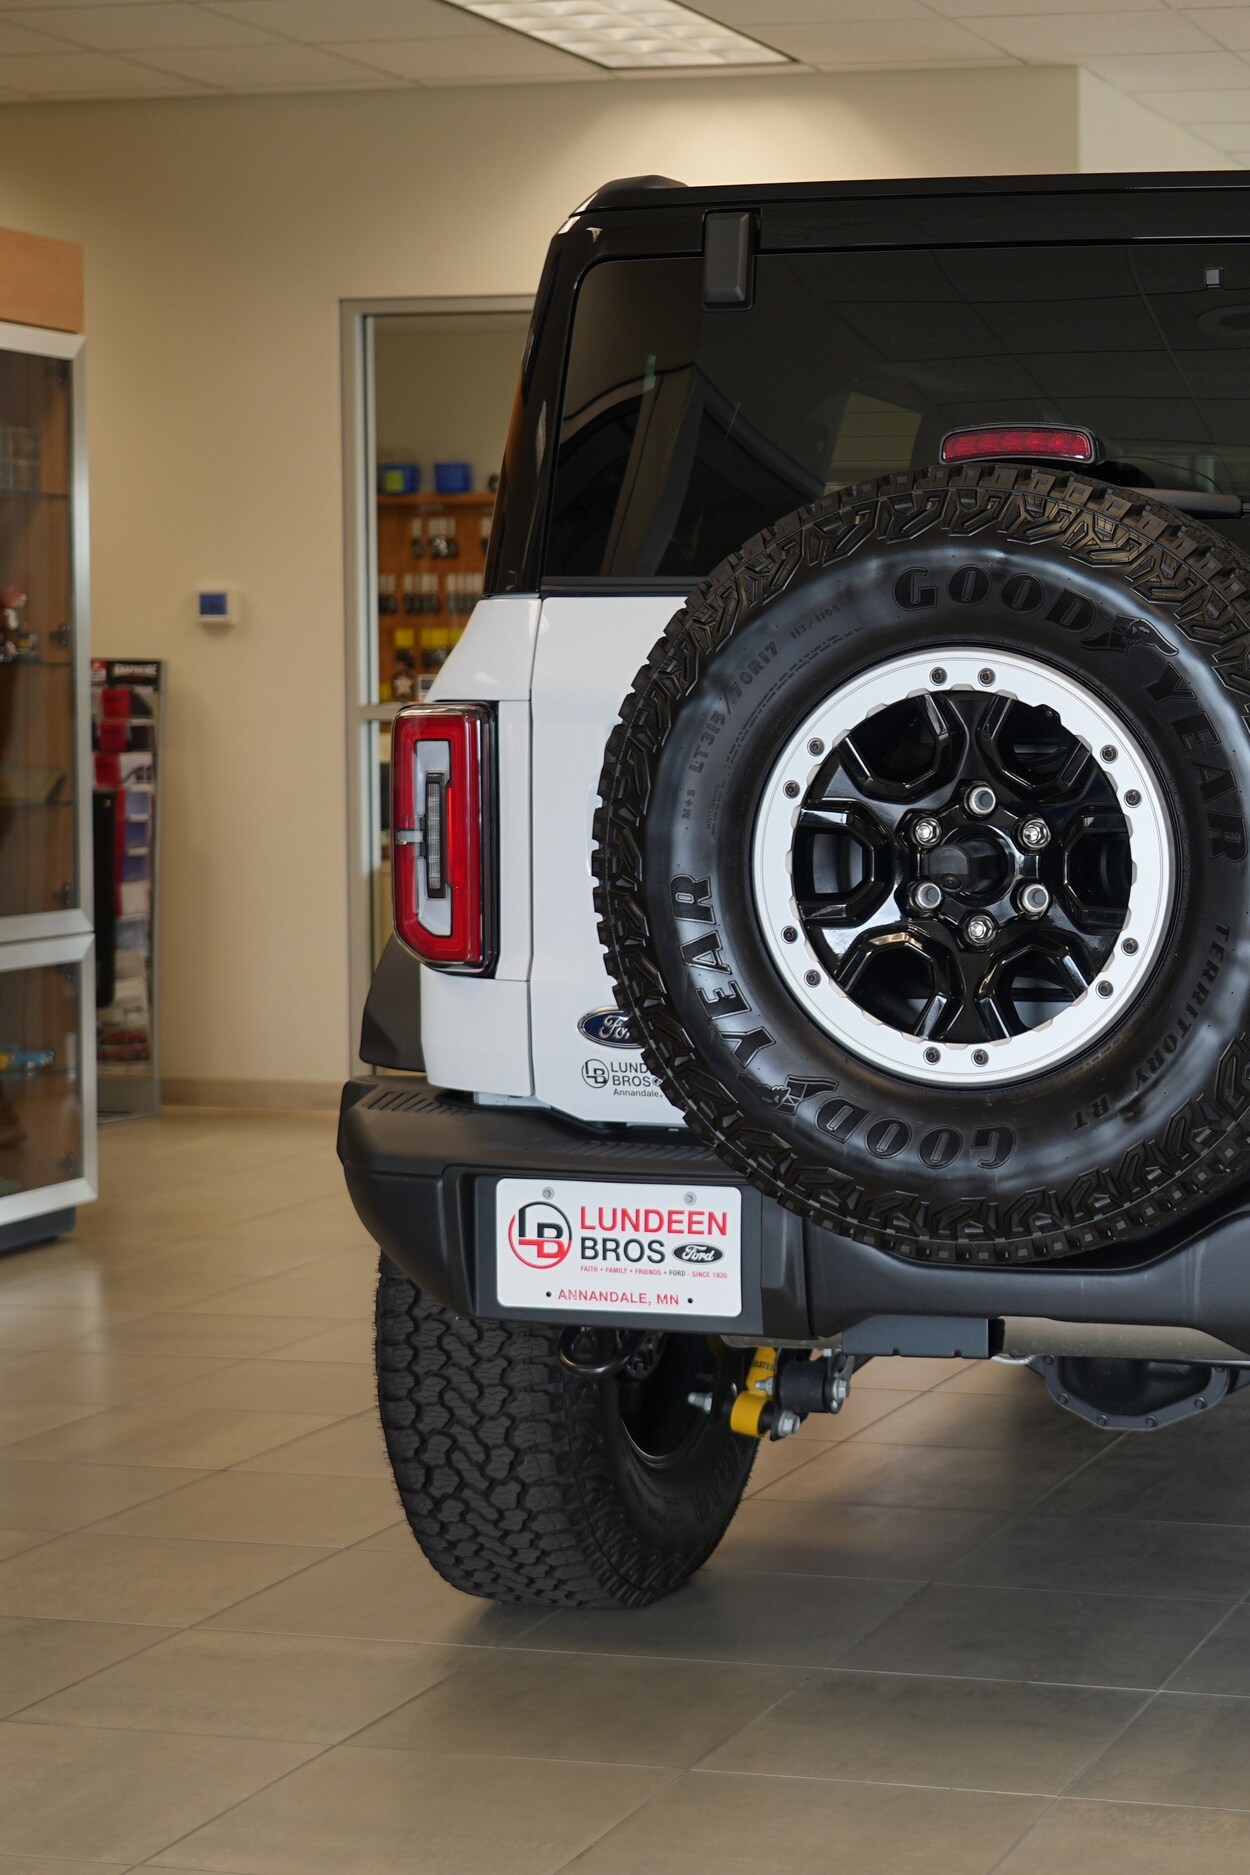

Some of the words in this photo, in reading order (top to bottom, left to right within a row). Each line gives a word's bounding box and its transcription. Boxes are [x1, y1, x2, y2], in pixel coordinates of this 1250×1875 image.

[1134, 924, 1232, 1091] TERRITORY
[611, 1061, 649, 1073] LUND
[612, 1075, 651, 1087] BROS
[613, 1088, 663, 1099] Annandale,
[1073, 1096, 1109, 1130] RT
[580, 1206, 728, 1236] LUNDEEN
[580, 1236, 666, 1264] BROS
[682, 1245, 716, 1261] Ford
[635, 1268, 661, 1276] FRIENDS
[558, 1289, 651, 1306] ANNANDALE,
[656, 1293, 680, 1305] MN
